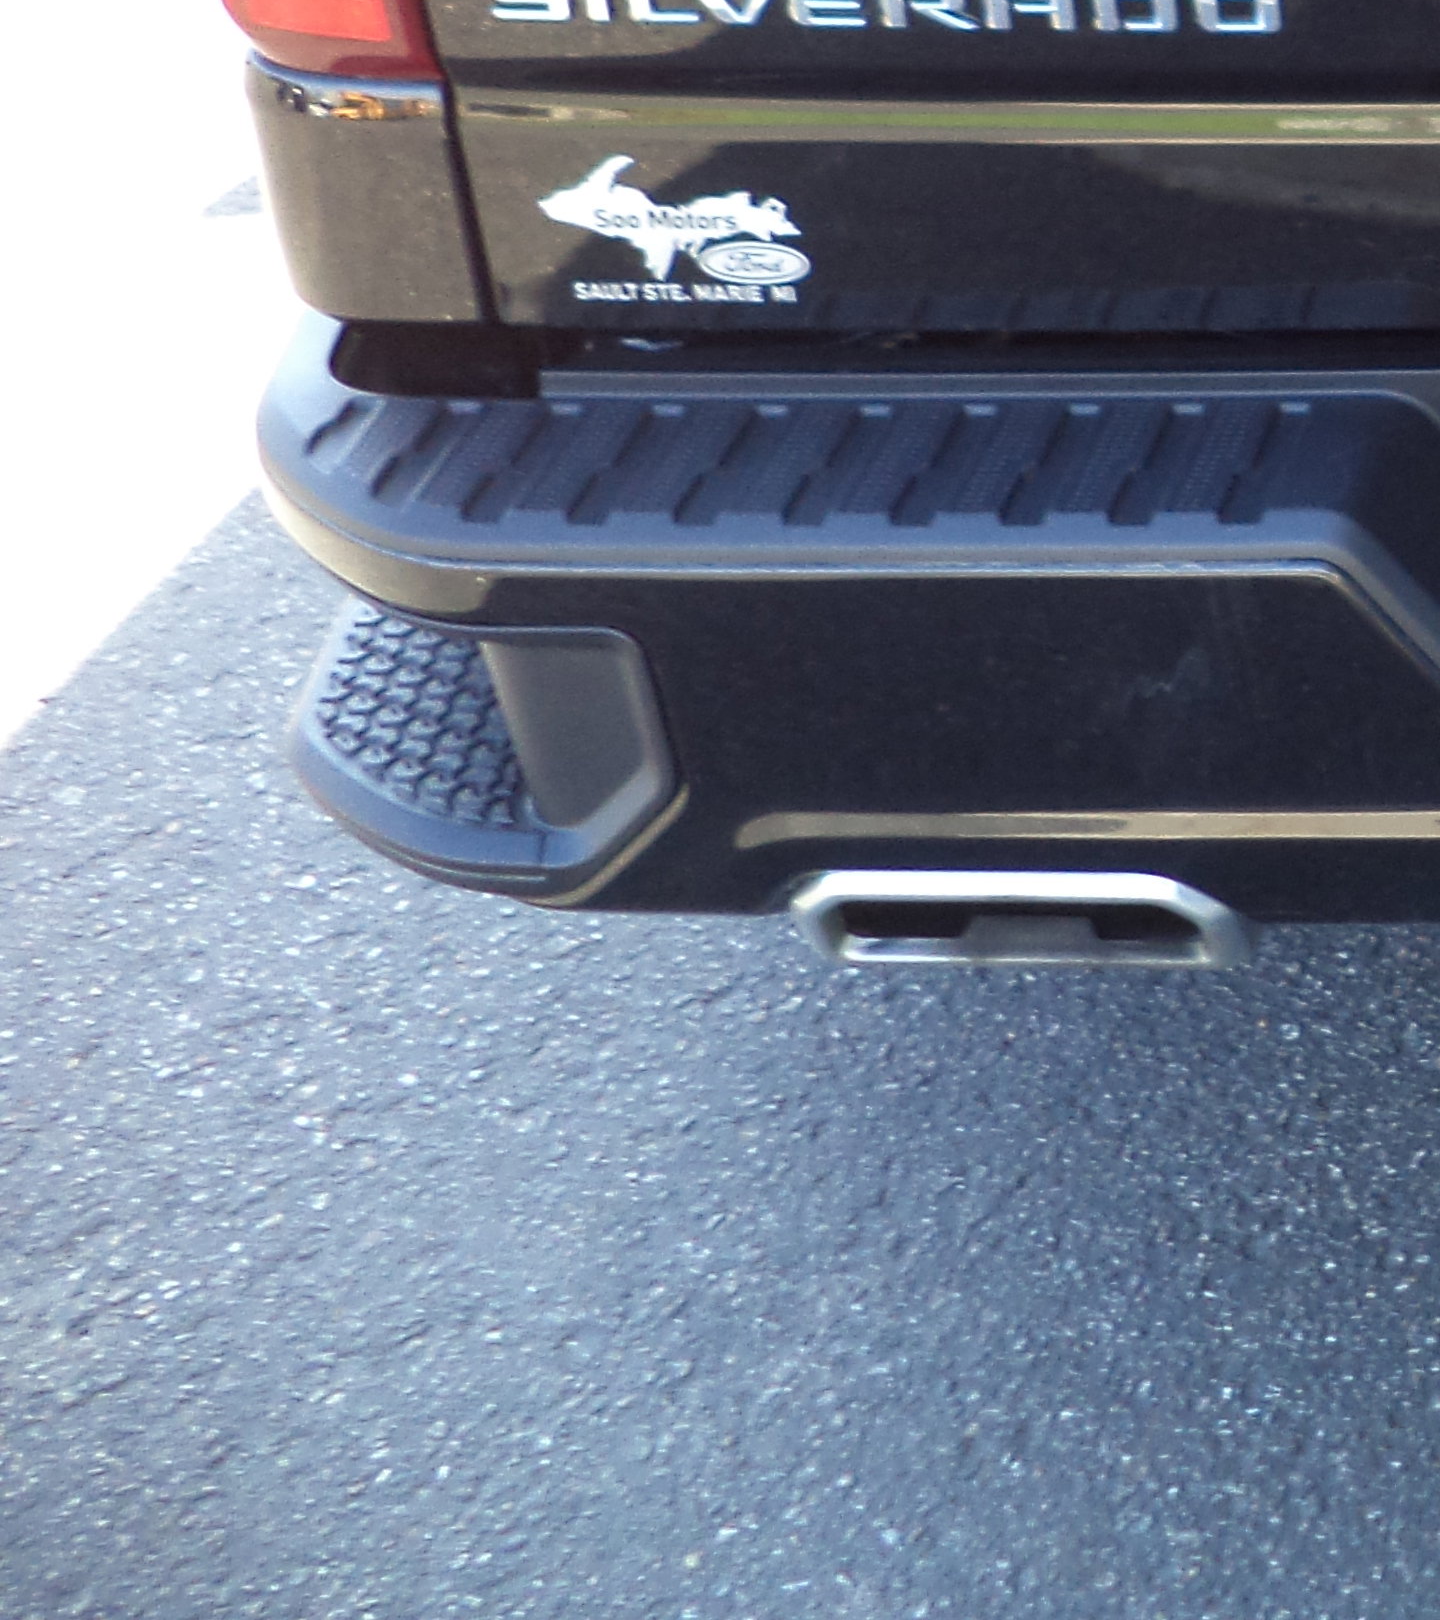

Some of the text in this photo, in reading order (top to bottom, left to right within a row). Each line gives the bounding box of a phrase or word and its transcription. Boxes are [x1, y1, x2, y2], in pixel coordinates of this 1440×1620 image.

[594, 209, 737, 230] Soo Motors
[573, 282, 639, 302] SAULT
[694, 283, 765, 303] MARIE
